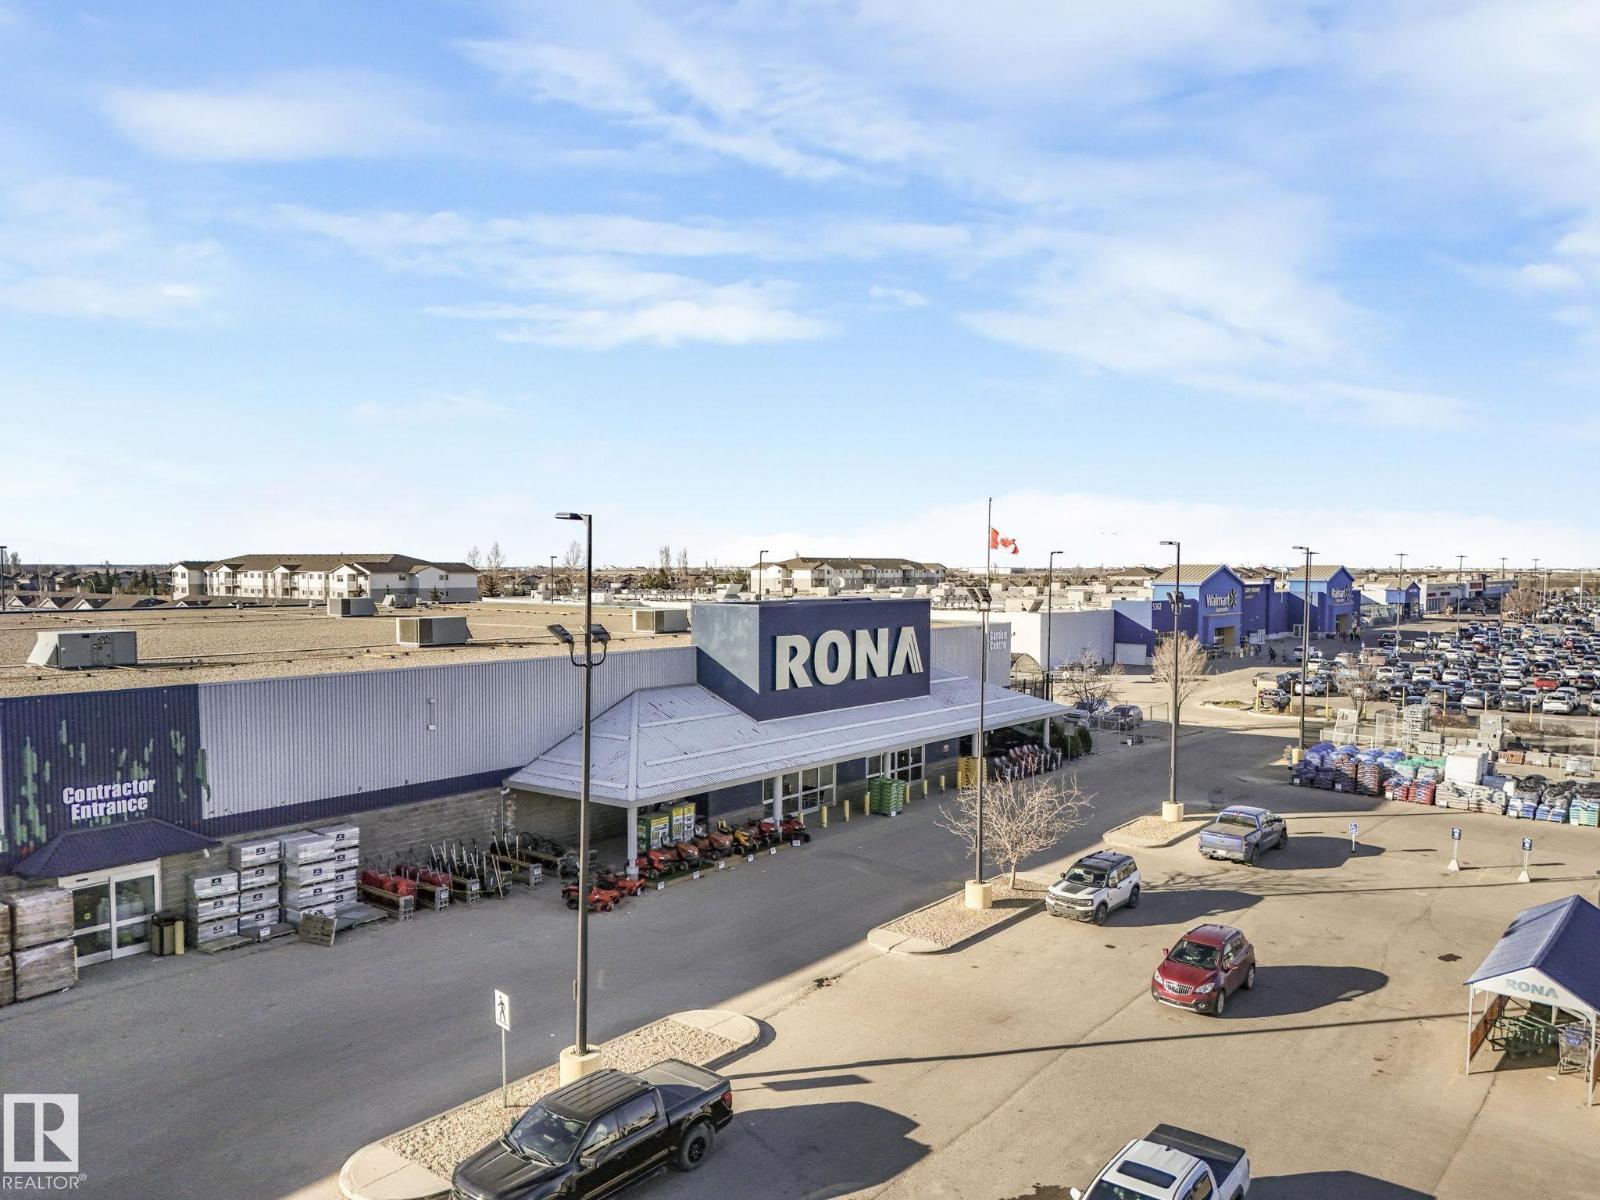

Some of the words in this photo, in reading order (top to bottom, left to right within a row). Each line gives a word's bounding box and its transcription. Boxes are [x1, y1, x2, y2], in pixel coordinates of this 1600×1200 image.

[1206, 593, 1230, 608] Walmart
[776, 626, 924, 690] RONA
[62, 779, 156, 805] Contractor
[71, 796, 148, 821] Entrance
[1504, 979, 1559, 999] RONA
